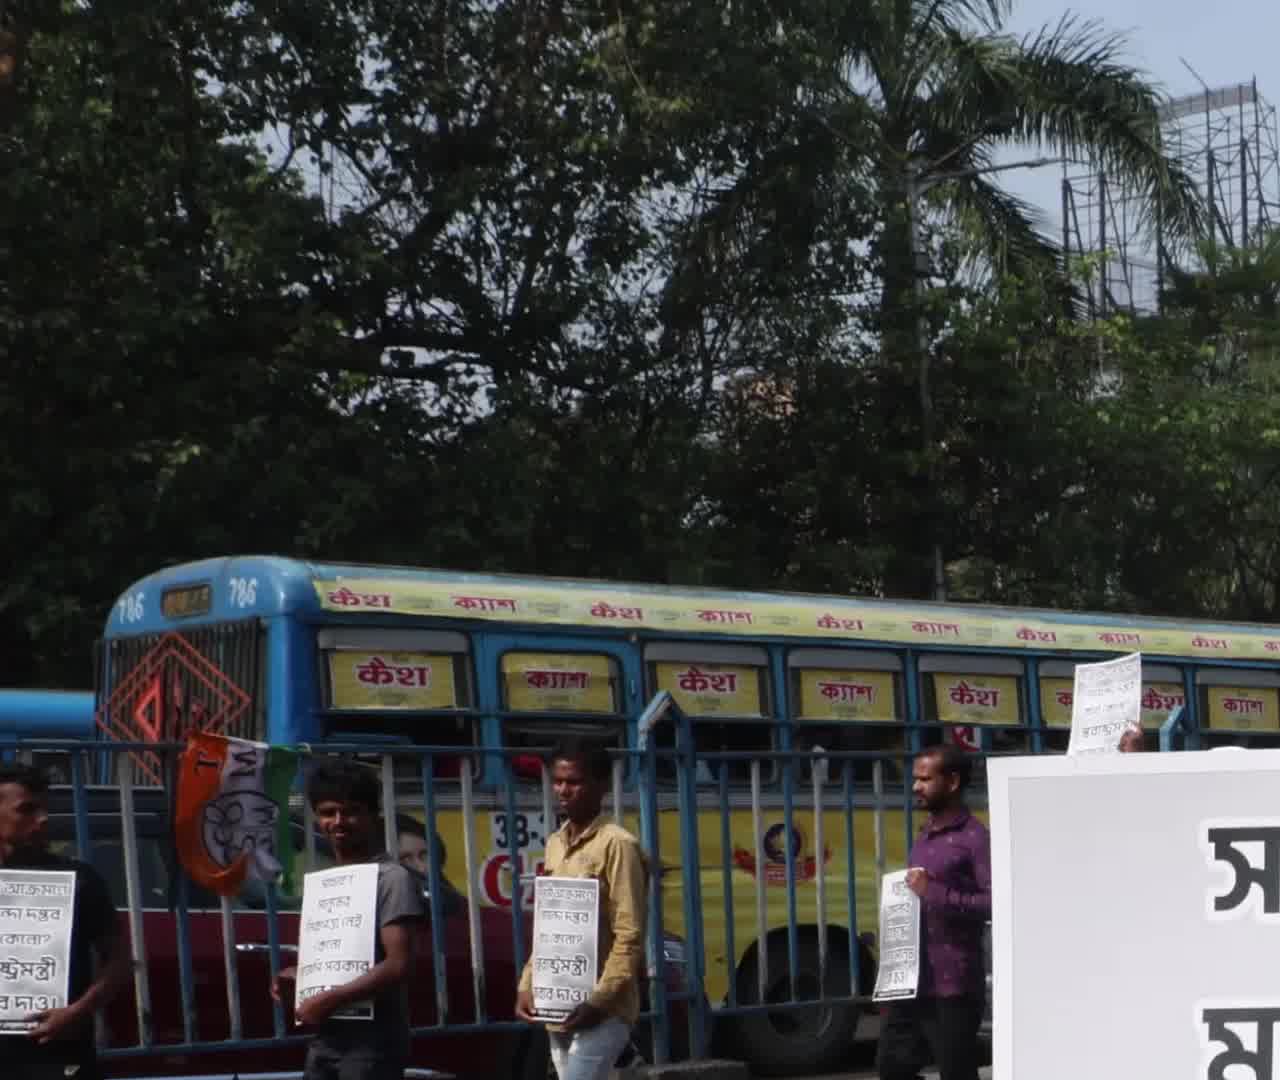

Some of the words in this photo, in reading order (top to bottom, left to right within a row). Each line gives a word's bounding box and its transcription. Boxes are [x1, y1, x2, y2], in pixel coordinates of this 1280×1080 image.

[229, 577, 258, 608] 786
[357, 656, 430, 687] कैश
[678, 665, 737, 693] कैश
[950, 681, 999, 708] कैश
